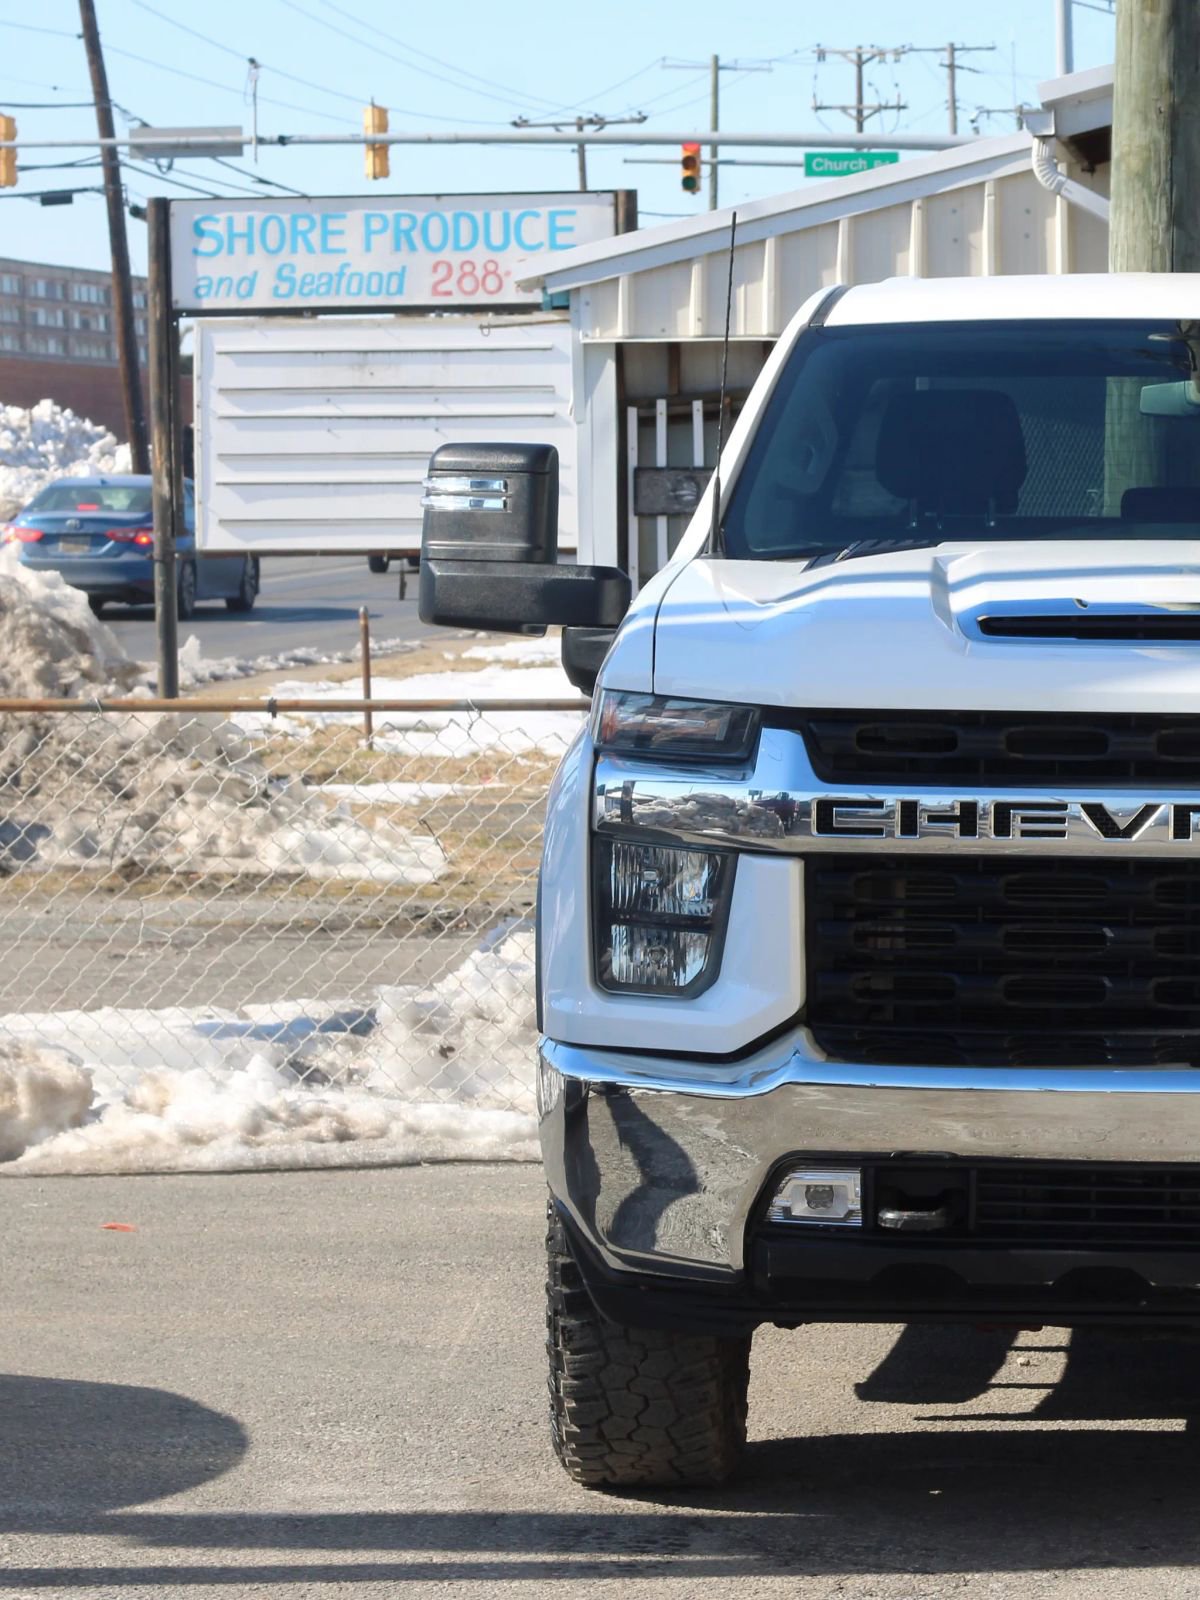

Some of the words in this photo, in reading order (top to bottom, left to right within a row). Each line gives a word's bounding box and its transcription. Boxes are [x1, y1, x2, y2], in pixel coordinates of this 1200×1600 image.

[811, 157, 868, 172] Church
[192, 211, 348, 258] SHORE
[363, 208, 579, 255] PRODUCE
[193, 270, 258, 299] and
[272, 262, 407, 299] Seafood
